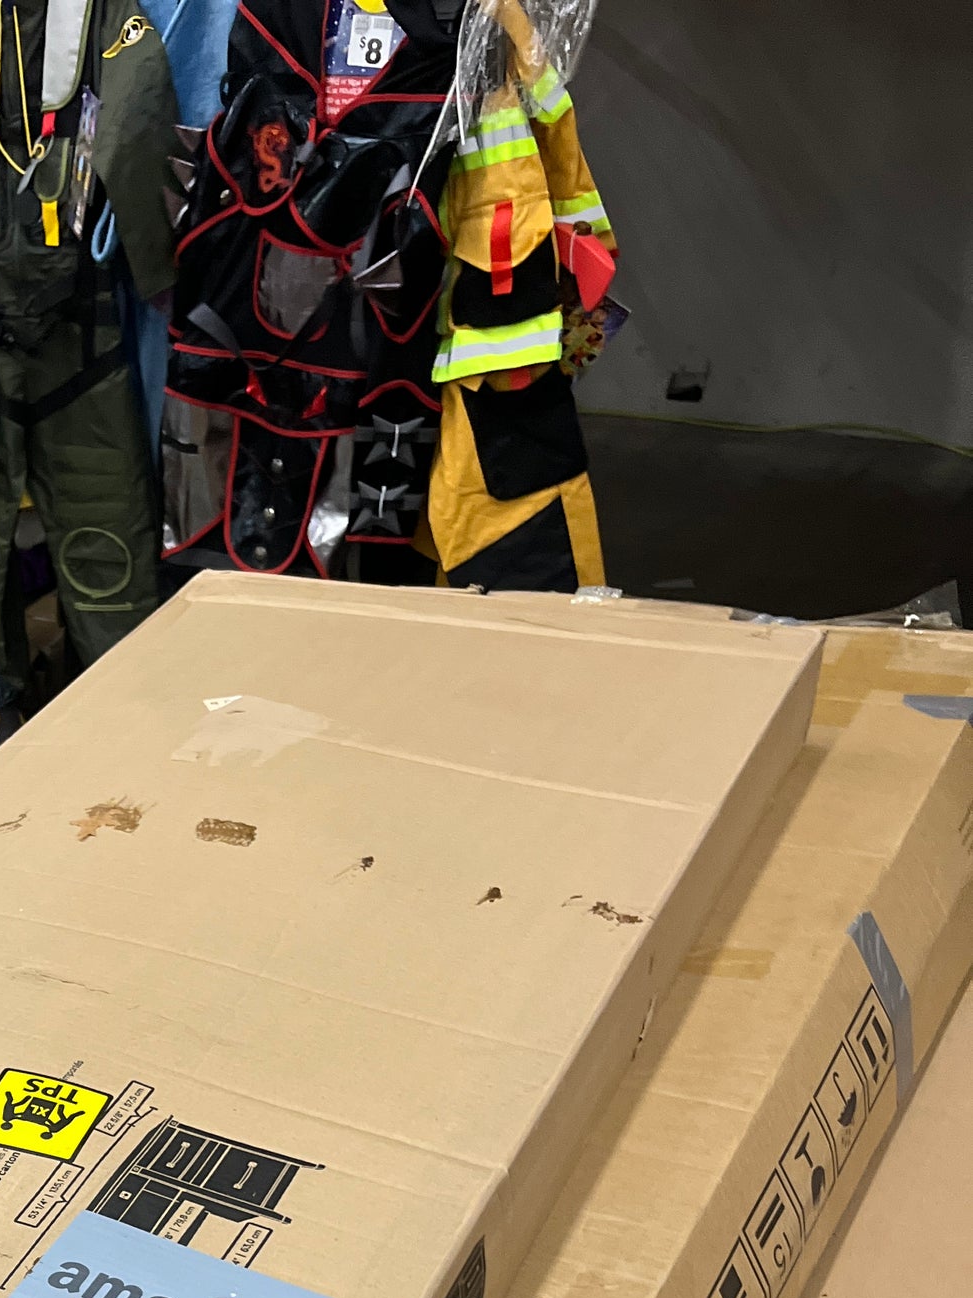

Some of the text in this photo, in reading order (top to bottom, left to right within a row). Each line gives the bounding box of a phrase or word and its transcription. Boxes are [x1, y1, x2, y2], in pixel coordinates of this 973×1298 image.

[359, 36, 383, 65] $8
[23, 1078, 79, 1105] TPS
[31, 1104, 49, 1117] XL
[104, 1122, 115, 1131] 22
[125, 1095, 137, 1107] 57,5
[134, 1088, 145, 1096] cm
[27, 1210, 39, 1220] 53
[49, 1178, 64, 1196] 135,1
[62, 1170, 72, 1179] cm
[185, 1206, 195, 1216] cm
[252, 1229, 262, 1239] cm
